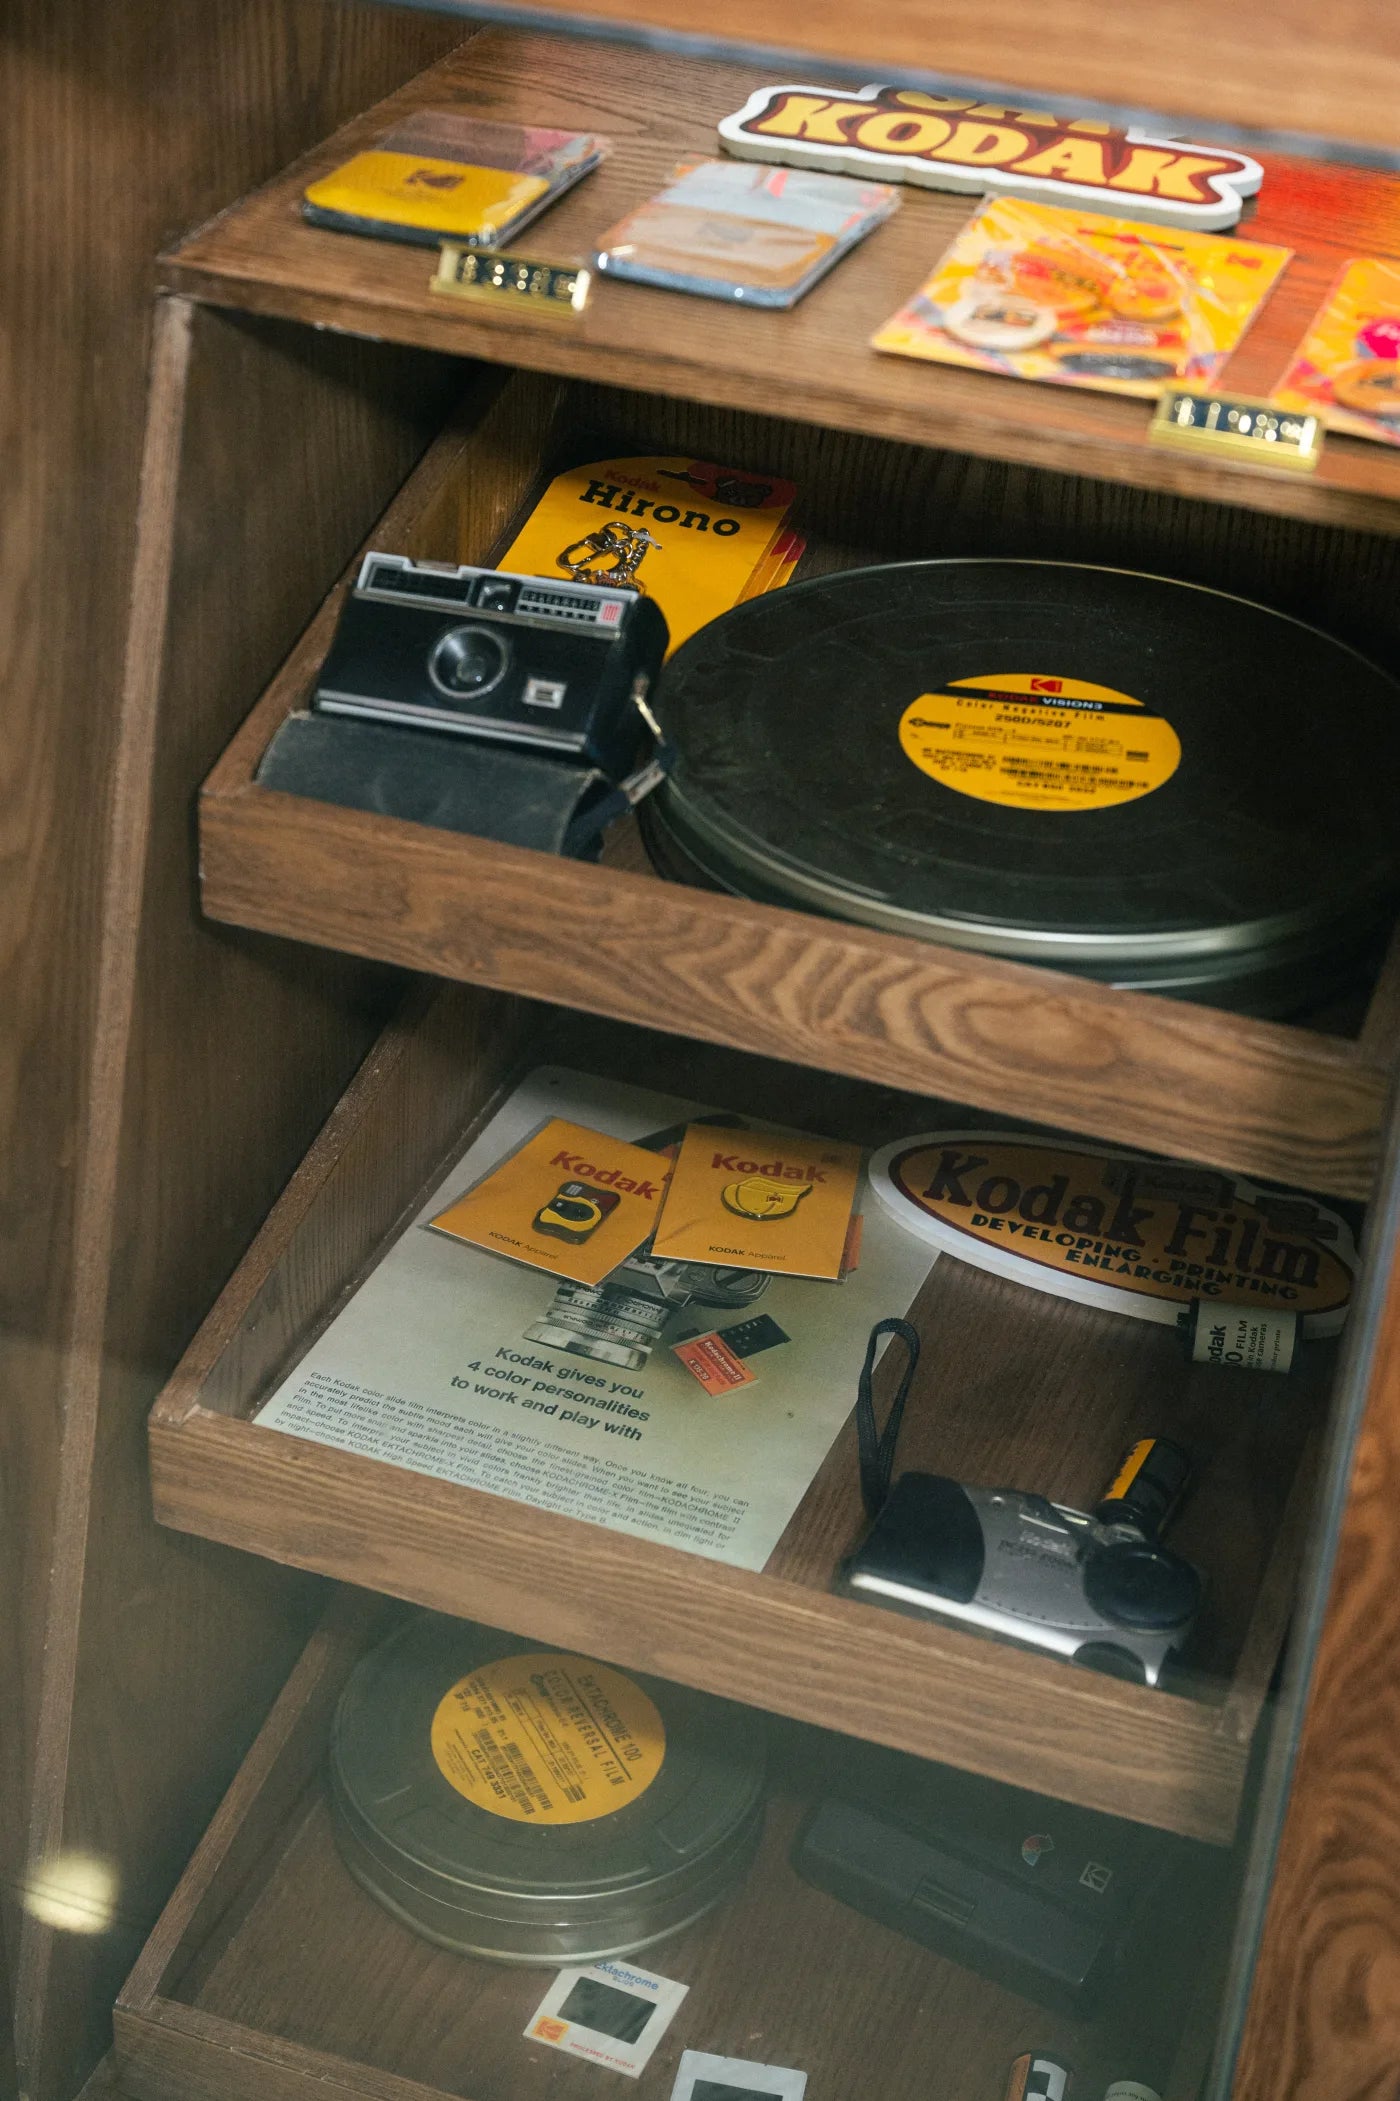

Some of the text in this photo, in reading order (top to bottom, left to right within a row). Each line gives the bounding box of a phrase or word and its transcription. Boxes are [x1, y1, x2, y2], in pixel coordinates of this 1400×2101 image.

[755, 96, 1229, 203] KODAK
[604, 469, 662, 493] Kodak
[579, 480, 740, 536] Hirono
[956, 699, 1105, 721] Color Negative Film
[1042, 697, 1103, 710] VISION3
[549, 1150, 661, 1200] Kodak
[711, 1153, 827, 1183] Kodak
[488, 1230, 559, 1260] KODAK Apparel
[922, 1150, 1320, 1288] Kodak Film
[708, 1245, 786, 1261] KODAK Apparel
[970, 1214, 1299, 1300] DEVELOPING PRINTING
[1065, 1248, 1223, 1295] ENLARGING
[704, 1340, 737, 1375] Kodachrome
[1207, 1325, 1227, 1363] odak
[1236, 1320, 1248, 1350] FILM
[1248, 1327, 1259, 1353] Kodak
[1258, 1323, 1267, 1355] cameras
[467, 1359, 651, 1422] 4 color personalities
[494, 1345, 645, 1400] Kodak gives you
[450, 1375, 644, 1441] to work and play with
[273, 1417, 285, 1426] by
[347, 1440, 381, 1454] KODAK
[286, 1403, 304, 1411] and
[336, 1417, 348, 1425] To
[389, 1434, 410, 1443] your
[413, 1441, 445, 1454] subject
[459, 1455, 480, 1464] vivid
[482, 1462, 510, 1474] colors
[512, 1470, 542, 1485] frankly
[545, 1480, 580, 1495] brighter
[583, 1492, 603, 1502] than
[303, 1381, 347, 1397] accurately
[348, 1394, 381, 1406] predict
[381, 1403, 396, 1411] the
[398, 1409, 424, 1419] subtle
[425, 1417, 452, 1427] mood
[453, 1425, 475, 1434] each
[493, 1437, 513, 1446] give
[514, 1444, 535, 1452] your
[536, 1450, 560, 1460] color
[591, 1465, 616, 1476] When
[617, 1474, 635, 1482] you
[636, 1480, 659, 1489] want
[660, 1485, 670, 1493] to
[671, 1490, 688, 1498] see
[688, 1495, 710, 1504] your
[712, 1502, 745, 1515] subject
[309, 1372, 332, 1382] Each
[332, 1379, 361, 1391] Kodak
[361, 1389, 384, 1398] color
[385, 1396, 405, 1404] slide
[407, 1401, 424, 1410] film
[425, 1406, 466, 1422] interprets
[467, 1420, 490, 1429] color
[510, 1433, 542, 1446] slightly
[543, 1441, 580, 1456] different
[604, 1459, 628, 1471] Once
[629, 1468, 647, 1476] you
[649, 1473, 673, 1484] know
[711, 1493, 729, 1501] you
[732, 1499, 749, 1507] can
[309, 1390, 324, 1398] the
[326, 1396, 348, 1405] most
[350, 1402, 379, 1415] lifelike
[381, 1413, 403, 1422] color
[405, 1420, 425, 1428] with
[428, 1427, 465, 1440] sharpest
[497, 1447, 528, 1459] choose
[531, 1456, 546, 1465] the
[612, 1482, 634, 1491] color
[343, 1411, 366, 1420] more
[407, 1430, 439, 1442] sparkle
[440, 1439, 457, 1448] into
[458, 1446, 478, 1454] your
[509, 1461, 541, 1473] choose
[660, 1505, 678, 1515] film
[699, 1518, 736, 1532] contrast
[346, 1430, 379, 1444] KODAK
[480, 1470, 492, 1478] To
[519, 1484, 539, 1493] your
[611, 1512, 630, 1520] and
[542, 1668, 576, 1705] COLOR
[566, 1705, 608, 1758] REVERSAL
[599, 1758, 625, 1787] FILM
[576, 1673, 643, 1763] EKTACHROME 100
[470, 1747, 486, 1763] CAT
